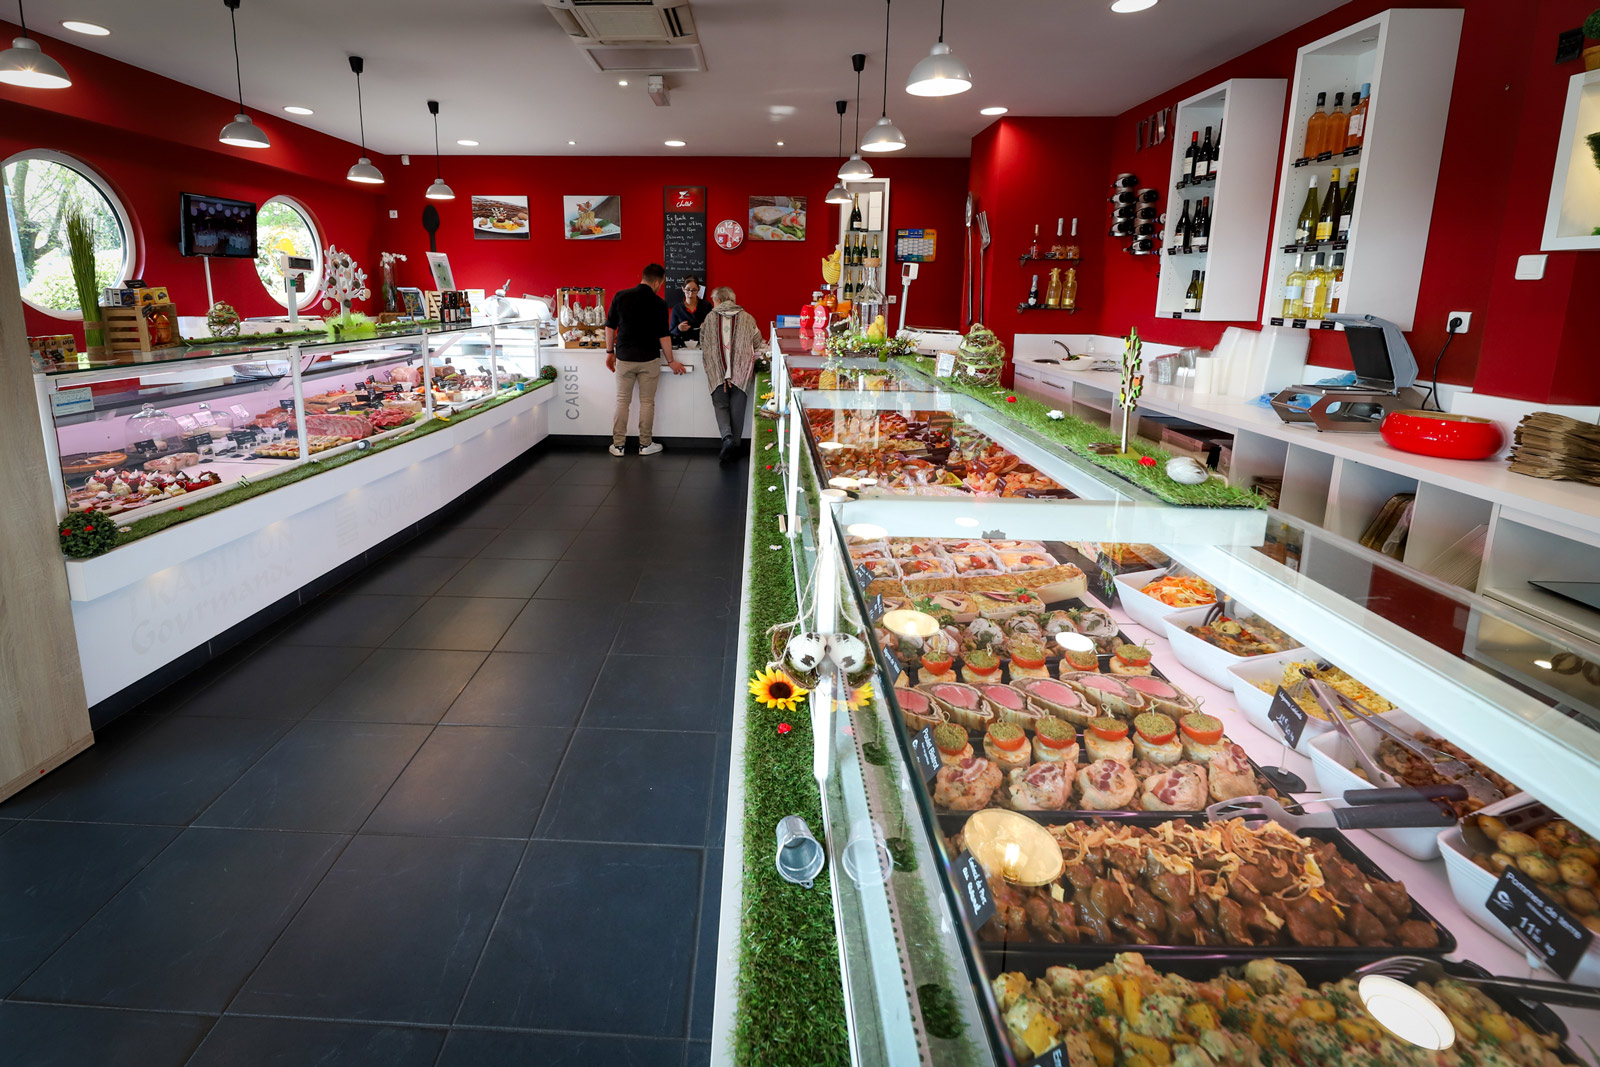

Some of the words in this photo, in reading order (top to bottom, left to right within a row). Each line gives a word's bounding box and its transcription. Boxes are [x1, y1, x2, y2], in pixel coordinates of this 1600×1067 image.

[717, 226, 725, 234] 10
[725, 221, 733, 229] 12
[726, 240, 732, 248] 6
[733, 235, 740, 243] 4
[564, 365, 580, 420] CAISSE
[922, 727, 933, 750] Poulet
[979, 888, 987, 906] Porc
[1505, 871, 1545, 908] Pommes
[1543, 905, 1559, 920] de
[1557, 916, 1583, 940] terre
